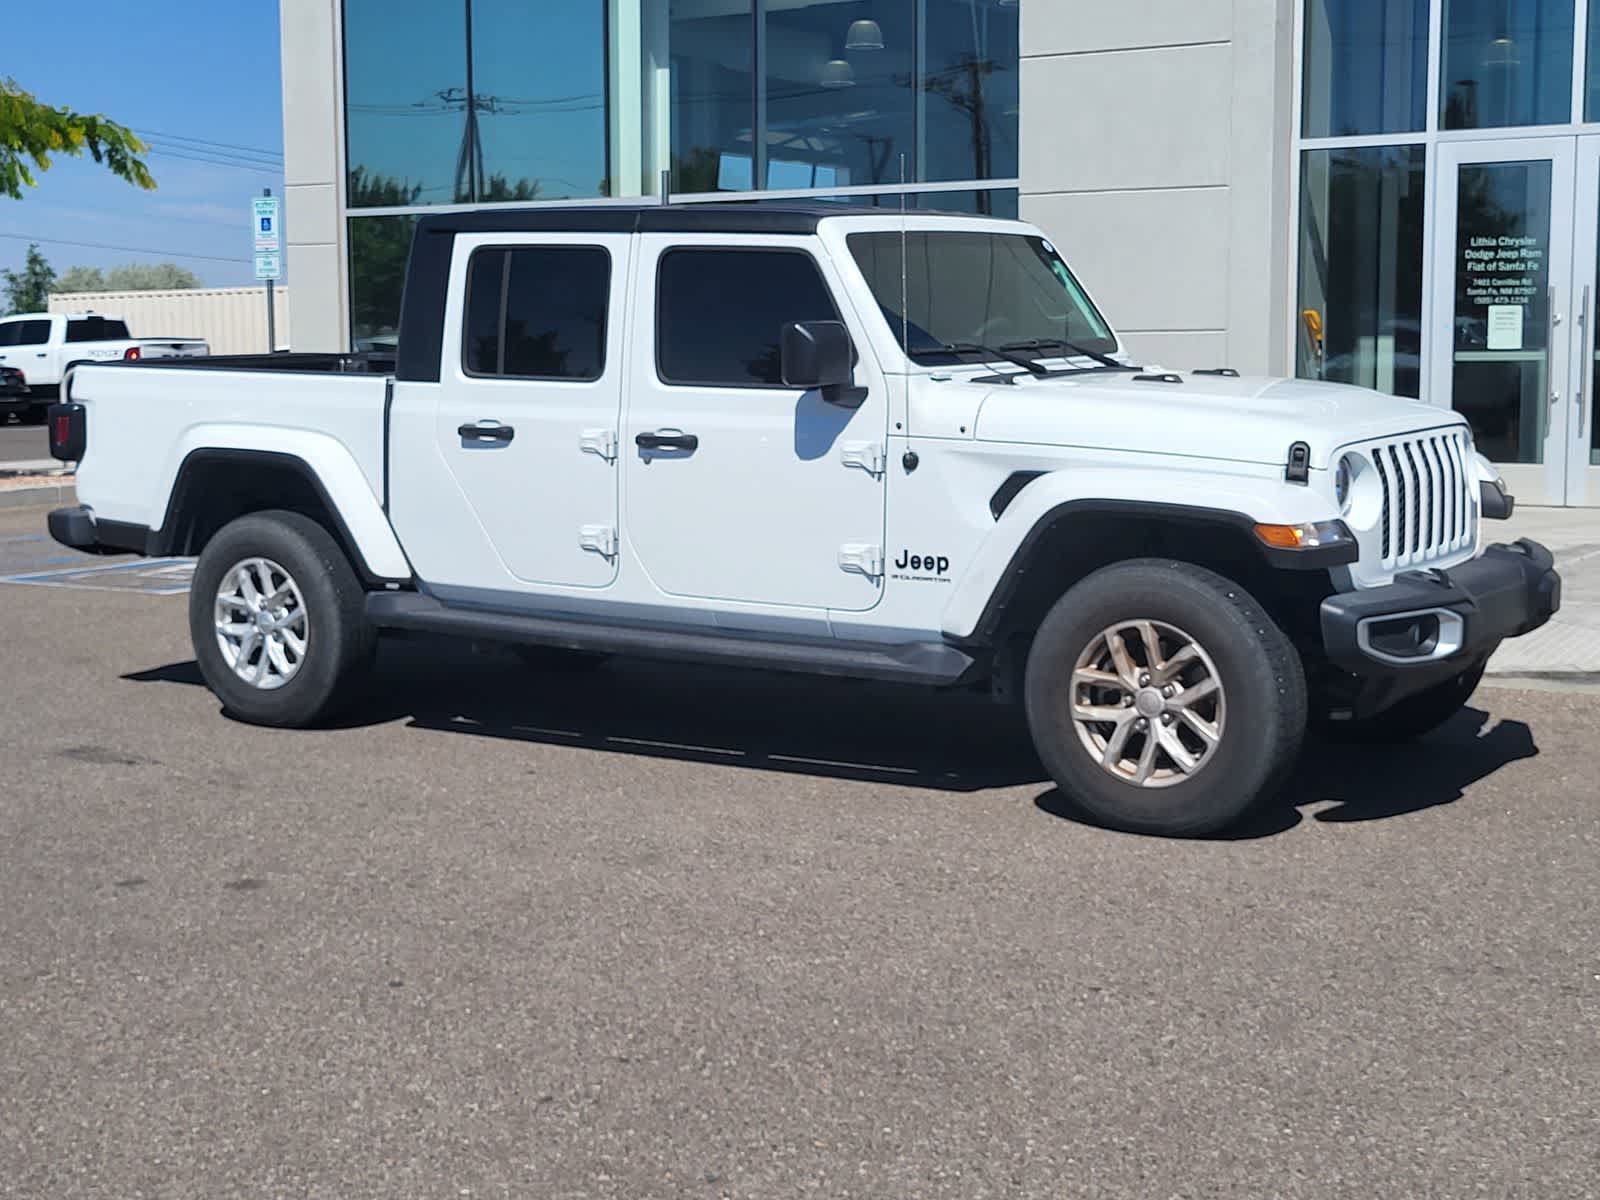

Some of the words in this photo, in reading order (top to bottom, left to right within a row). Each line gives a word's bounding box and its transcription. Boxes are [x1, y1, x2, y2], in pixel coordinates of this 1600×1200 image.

[1470, 236, 1497, 247] Lithia
[1498, 236, 1537, 248] Chrysler
[1464, 249, 1495, 260] Dodge
[1496, 249, 1519, 260] Jeep
[1520, 248, 1542, 258] Ram
[1466, 261, 1486, 272] Fiat
[1486, 261, 1497, 272] of
[1498, 261, 1526, 272] Santa
[1527, 260, 1539, 271] Fe
[895, 549, 949, 575] Jeep
